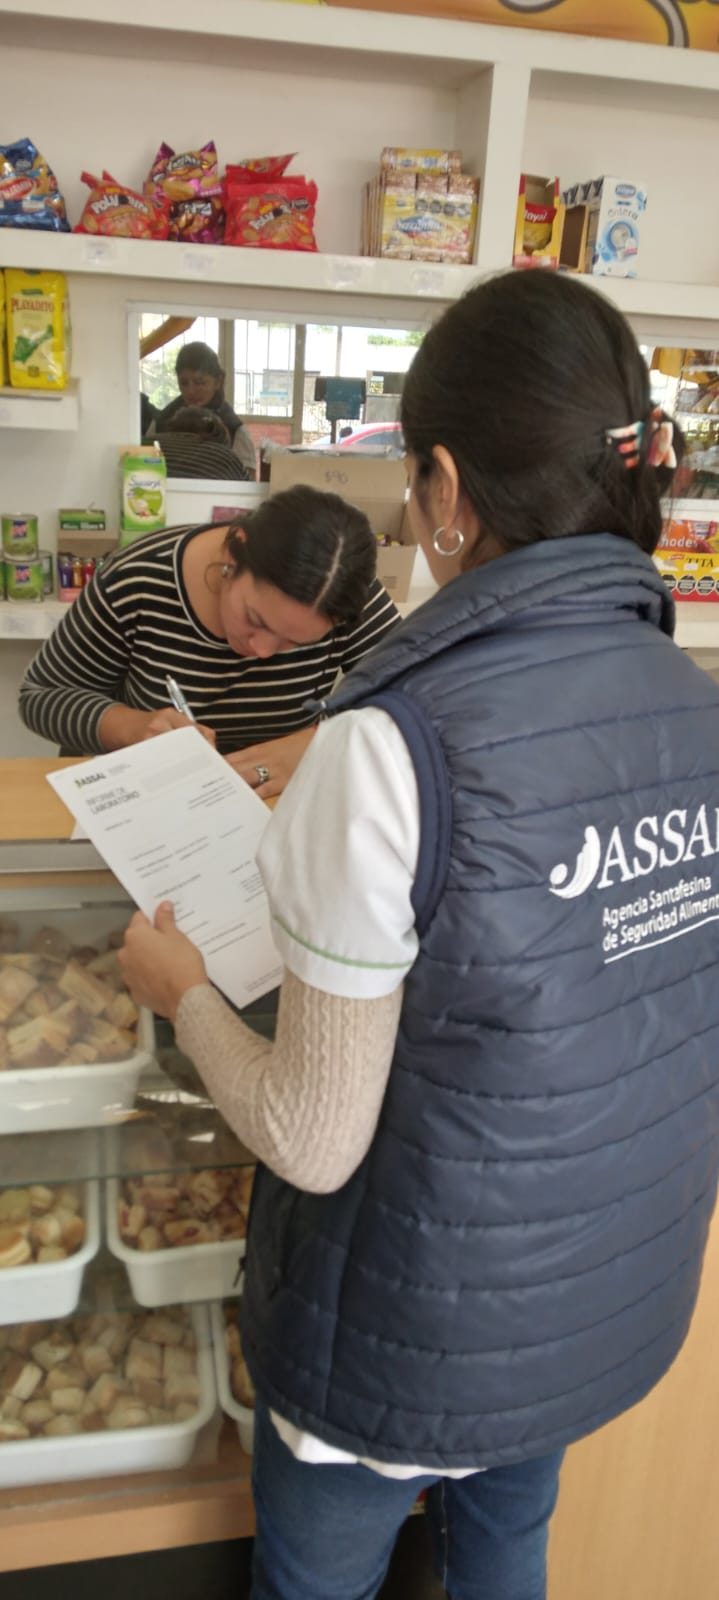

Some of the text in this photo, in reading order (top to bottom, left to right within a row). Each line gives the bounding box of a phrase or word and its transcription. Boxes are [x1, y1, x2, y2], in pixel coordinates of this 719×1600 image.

[597, 803, 719, 889] ASSA
[602, 876, 712, 929] Agencia Santafesina
[602, 931, 619, 951] de
[620, 906, 678, 944] Seguridad
